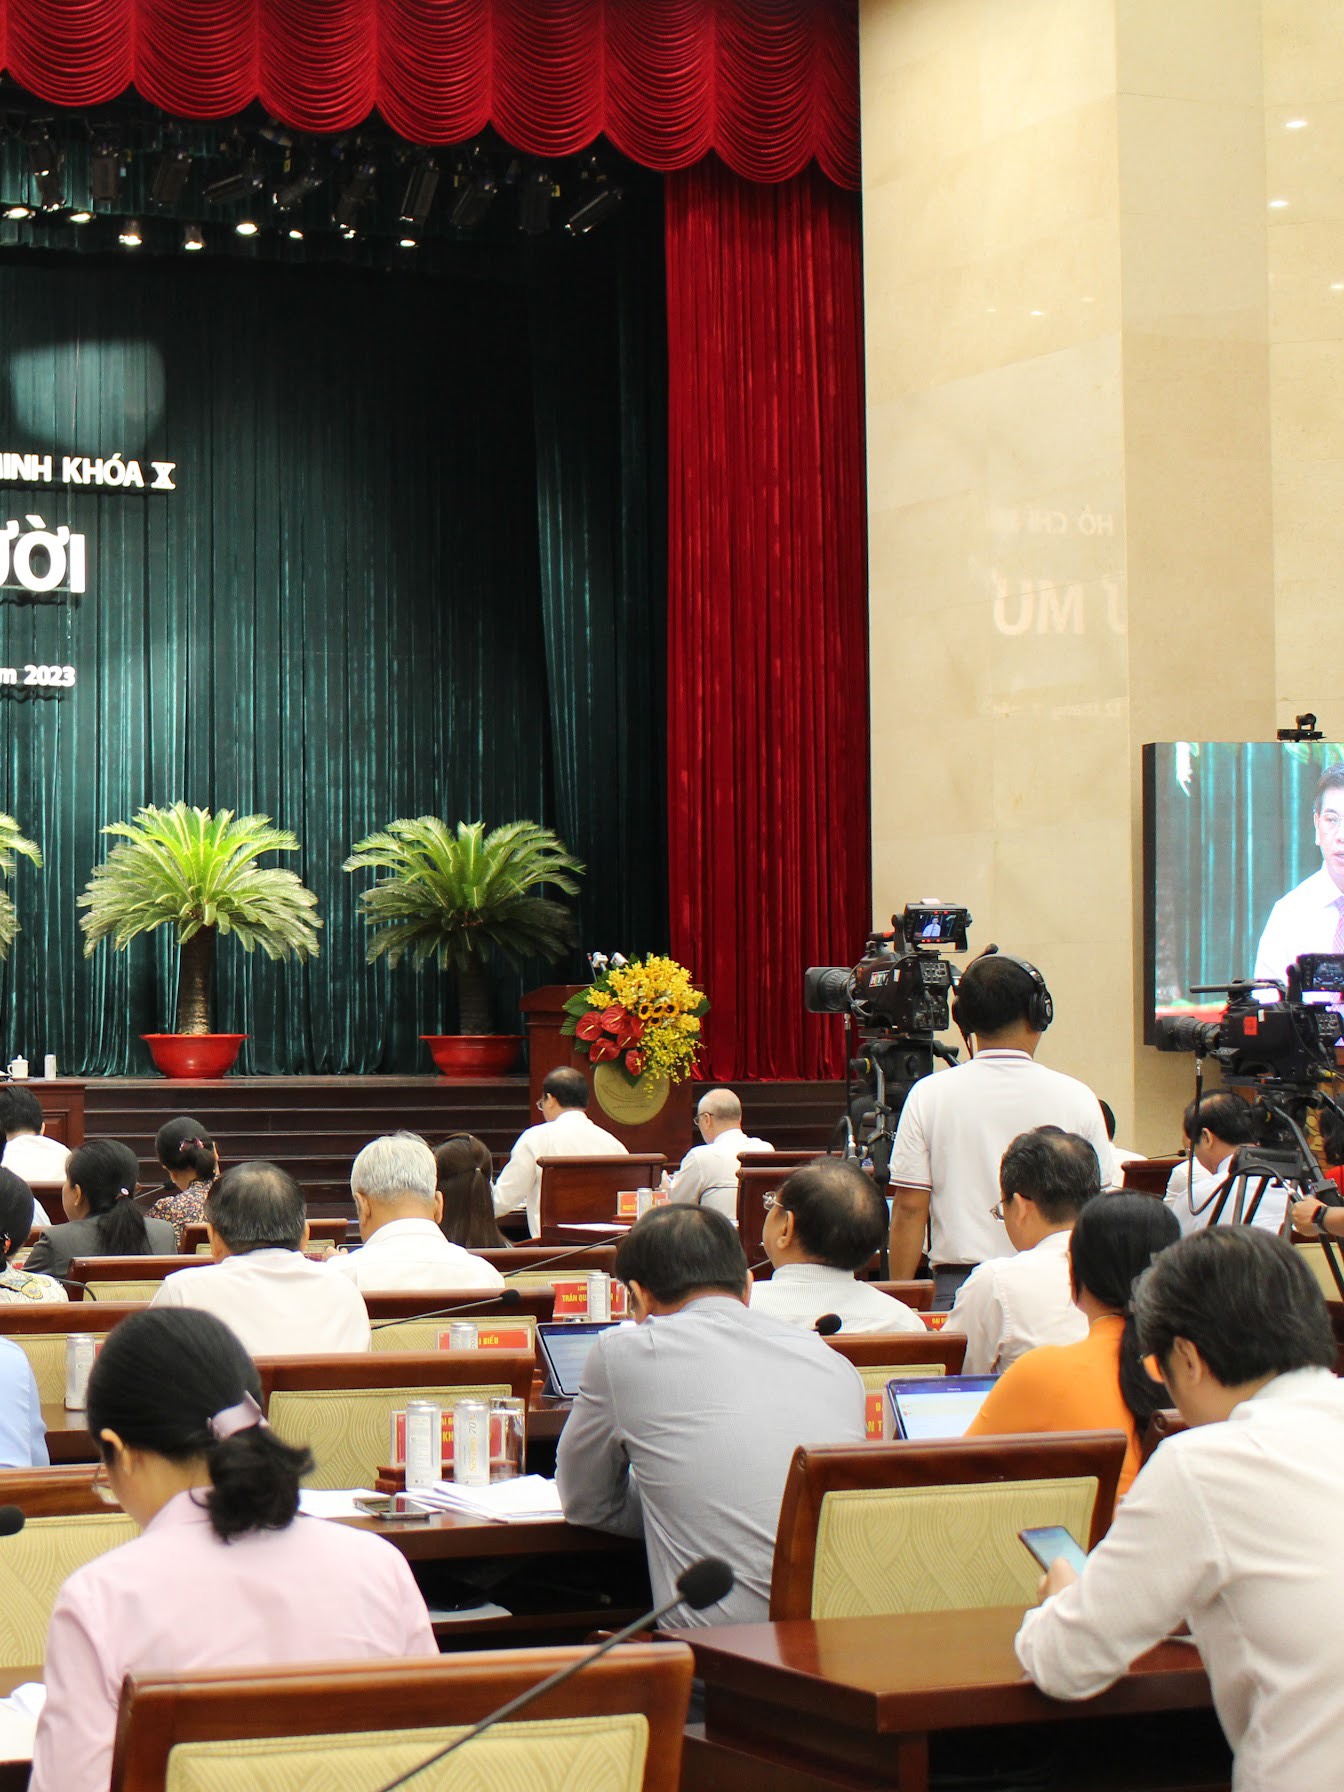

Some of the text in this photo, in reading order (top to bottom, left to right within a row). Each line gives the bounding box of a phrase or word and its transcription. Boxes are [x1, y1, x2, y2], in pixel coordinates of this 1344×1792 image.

[63, 453, 145, 488] KHÓA
[151, 462, 176, 490] X
[24, 665, 76, 688] 2023
